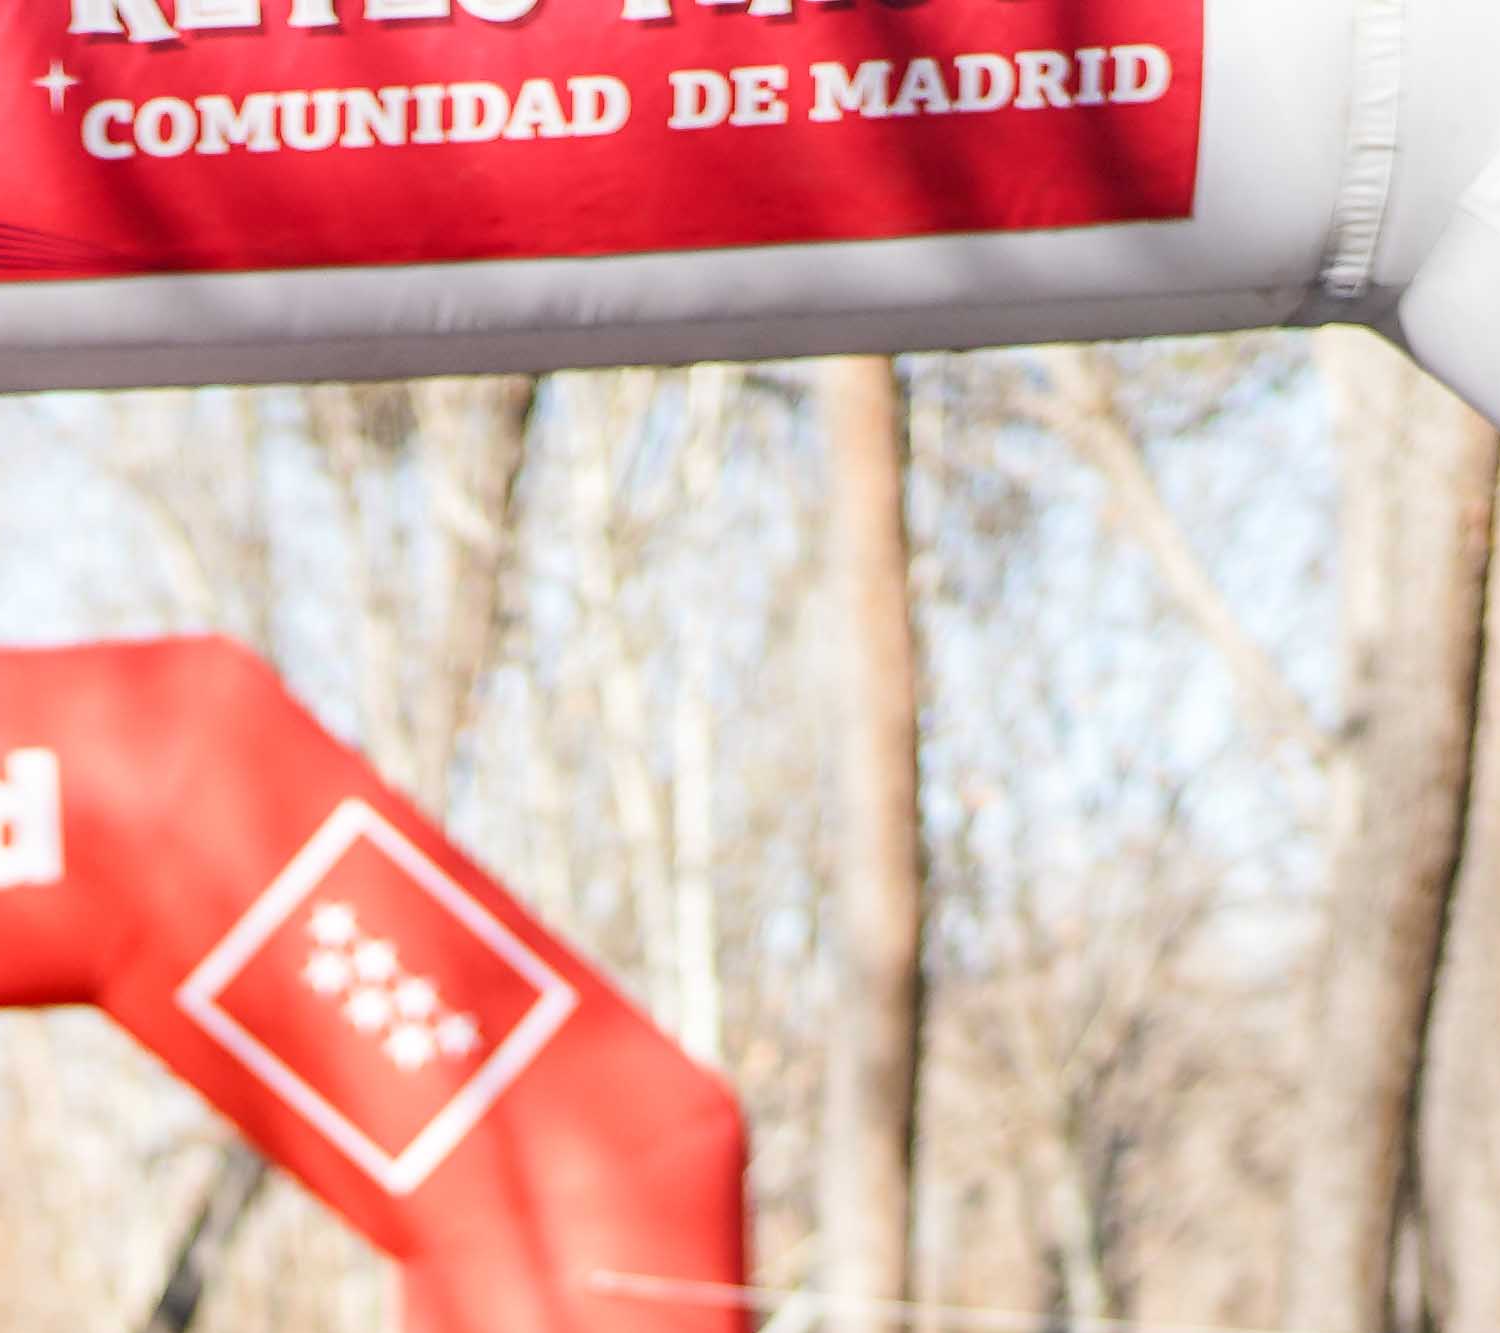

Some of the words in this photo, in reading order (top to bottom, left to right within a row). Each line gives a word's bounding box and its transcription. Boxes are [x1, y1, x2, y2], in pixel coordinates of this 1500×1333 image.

[81, 75, 629, 160] COMUNIDAD
[669, 67, 788, 129] DE
[811, 43, 1171, 122] MADRID
